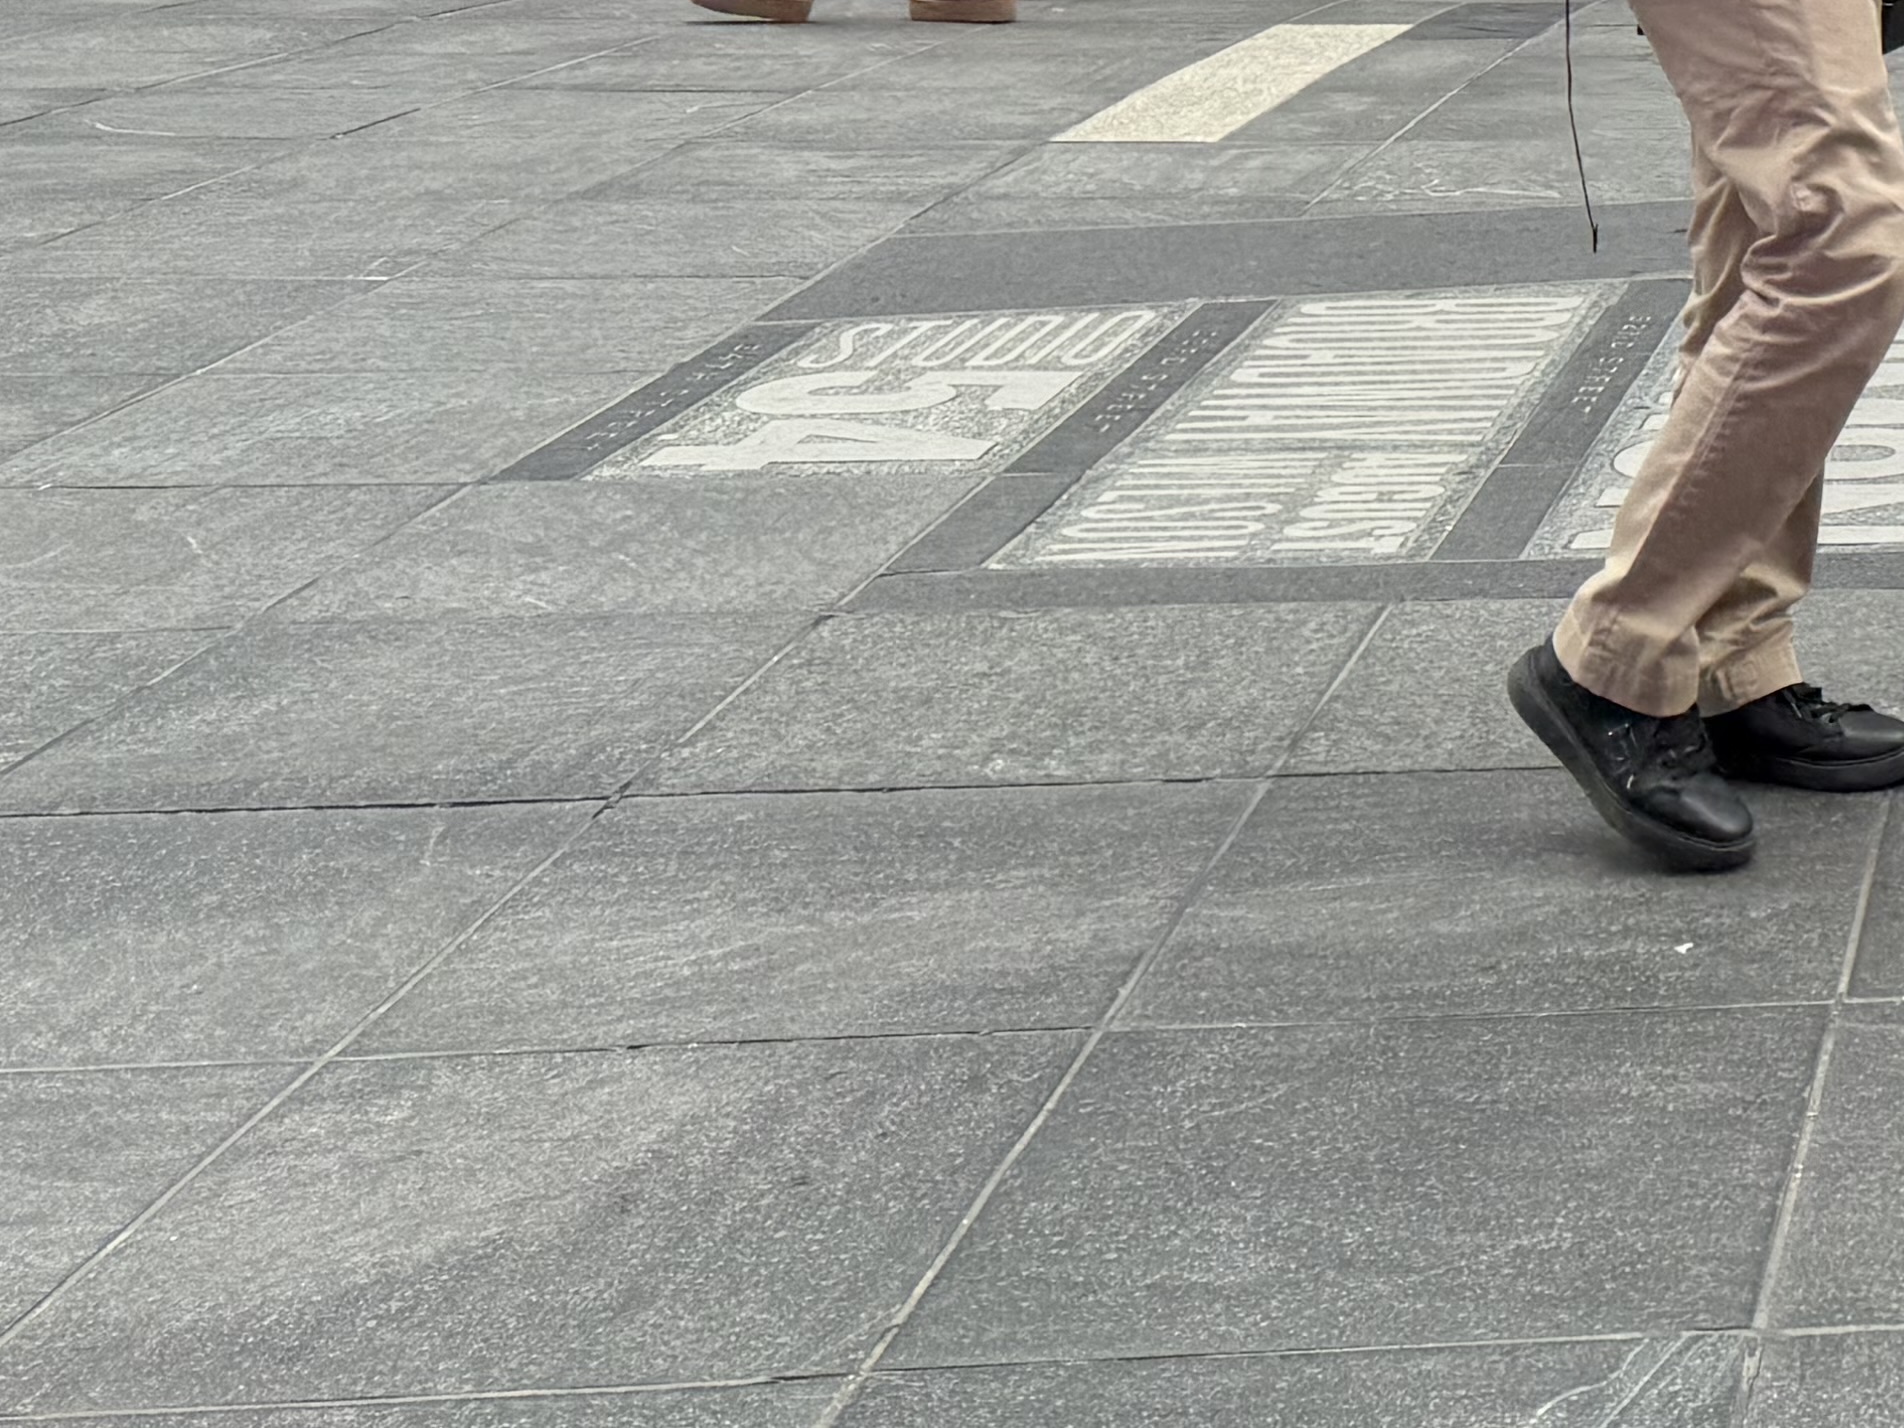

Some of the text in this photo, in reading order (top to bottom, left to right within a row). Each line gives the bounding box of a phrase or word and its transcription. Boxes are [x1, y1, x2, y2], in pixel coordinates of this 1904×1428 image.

[798, 310, 1157, 368] STUDIO
[1161, 294, 1586, 442] BROADWAY
[637, 370, 1085, 471] 54
[1032, 452, 1335, 563] WILSON
[1271, 452, 1471, 554] AUGUST
